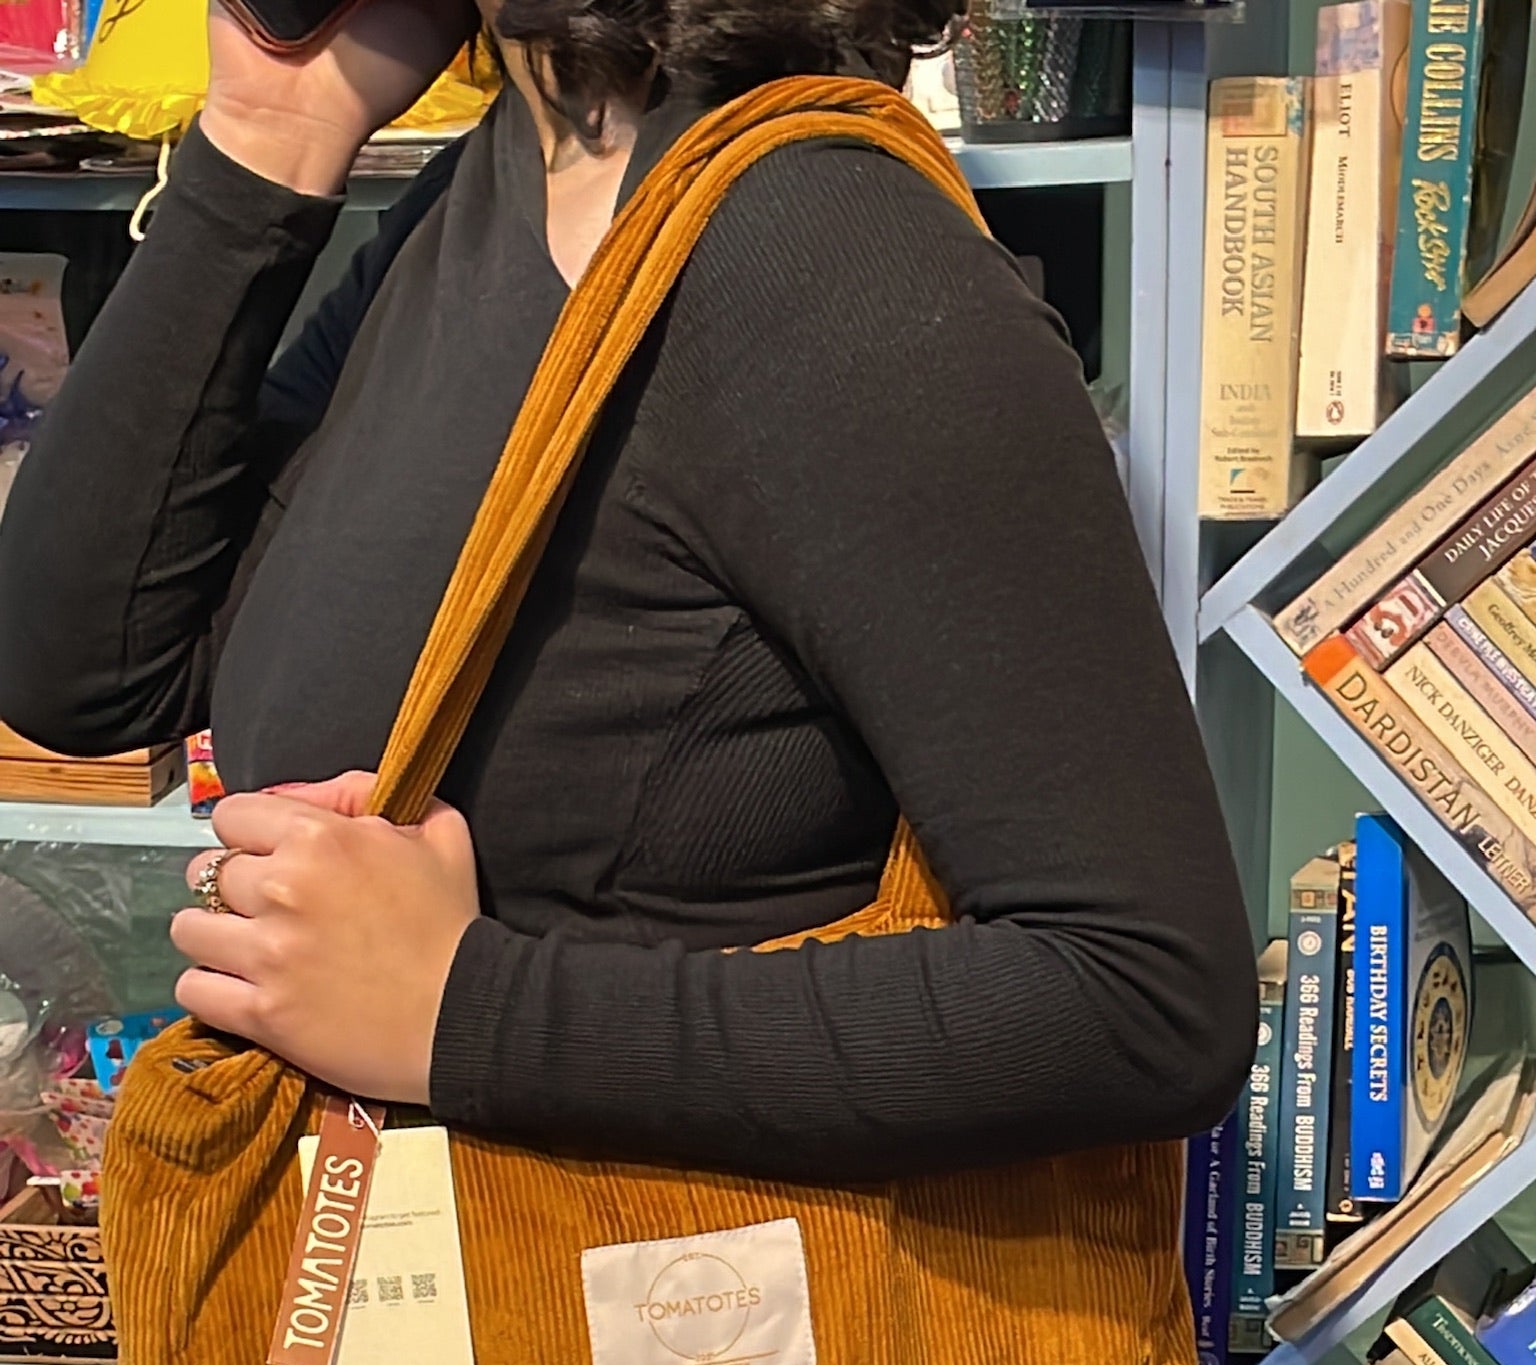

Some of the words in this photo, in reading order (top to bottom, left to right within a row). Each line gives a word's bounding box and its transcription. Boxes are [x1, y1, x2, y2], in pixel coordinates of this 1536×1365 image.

[1338, 83, 1352, 137] ELIOT
[1417, 43, 1467, 161] COLLINS
[1221, 147, 1249, 317] HANDBOOK
[1252, 145, 1279, 245] SOUTH
[1411, 178, 1450, 237] Rock
[1249, 253, 1275, 342] ASIAN
[1219, 383, 1272, 400] INDIA
[1324, 598, 1338, 611] A
[1332, 540, 1397, 601] Hundred
[1399, 522, 1423, 546] and
[1421, 494, 1454, 523] One
[1452, 461, 1492, 495] Days
[1443, 522, 1485, 564] DAILY
[1482, 497, 1515, 530] LIFE
[1511, 480, 1532, 502] OF
[1487, 603, 1526, 646] Geoffrey
[1405, 664, 1444, 706] NICK
[1438, 702, 1506, 777] DANZIGER
[1335, 670, 1482, 836] DARDISTAN
[1477, 835, 1532, 895] LEITNER
[1299, 974, 1320, 1004] 366
[1369, 925, 1389, 1022] BIRTHDAY
[1293, 1006, 1319, 1070] Readings
[1369, 1024, 1389, 1102] SECRETS
[1250, 1064, 1271, 1093] 366
[1244, 1096, 1269, 1158] Readings
[1293, 1114, 1316, 1192] BUDDHISM
[1206, 1171, 1221, 1220] Garland
[282, 1154, 365, 1351] TOMATOTES
[1204, 1236, 1218, 1267] Birth
[1243, 1202, 1265, 1276] BUDDHISM
[632, 1287, 762, 1323] TOMATOTES
[1202, 1268, 1217, 1309] Stories
